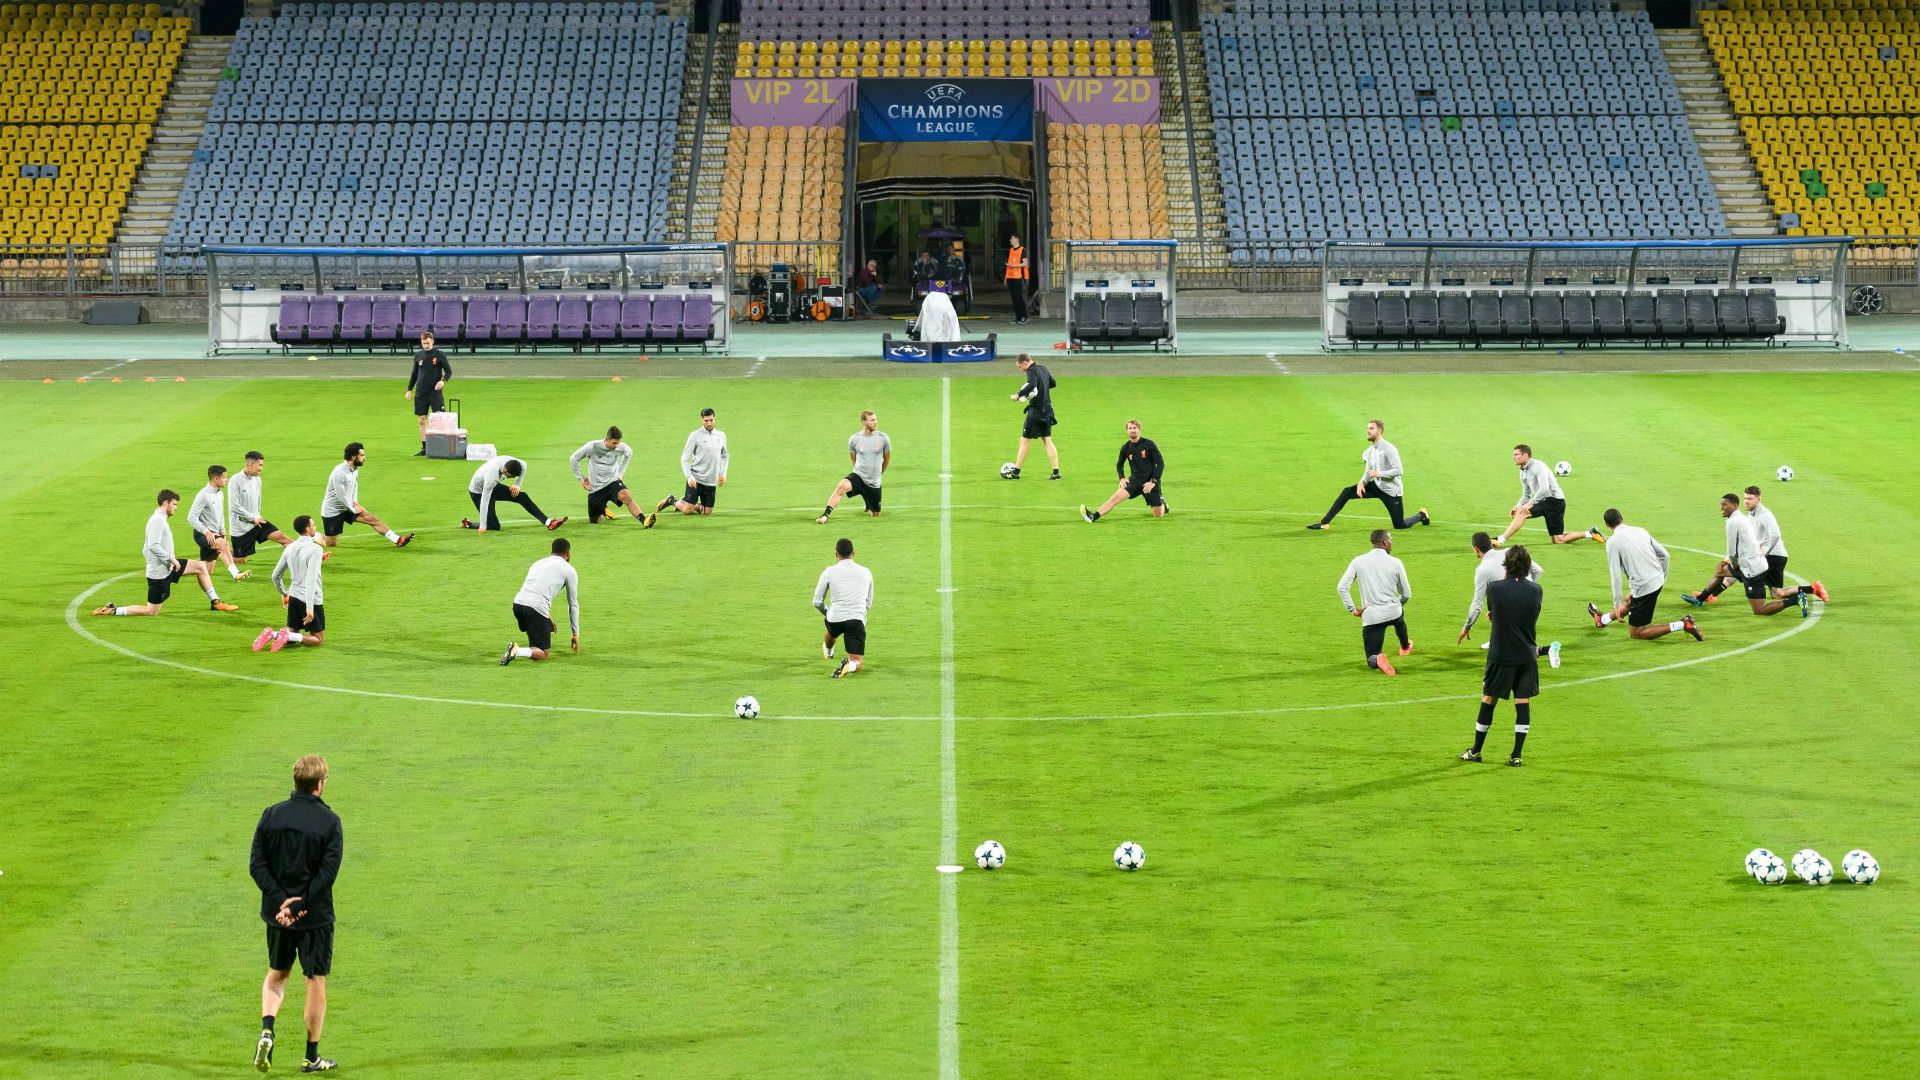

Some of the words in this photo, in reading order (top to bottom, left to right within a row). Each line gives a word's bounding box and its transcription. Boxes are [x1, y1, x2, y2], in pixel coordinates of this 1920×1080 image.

[744, 80, 791, 104] VIP
[803, 80, 838, 104] 2L
[927, 86, 962, 101] UEFA
[1056, 79, 1103, 103] VIP
[1112, 79, 1151, 103] 2D
[887, 104, 1004, 119] CHAMPIONS
[916, 122, 975, 133] LEAGUE
